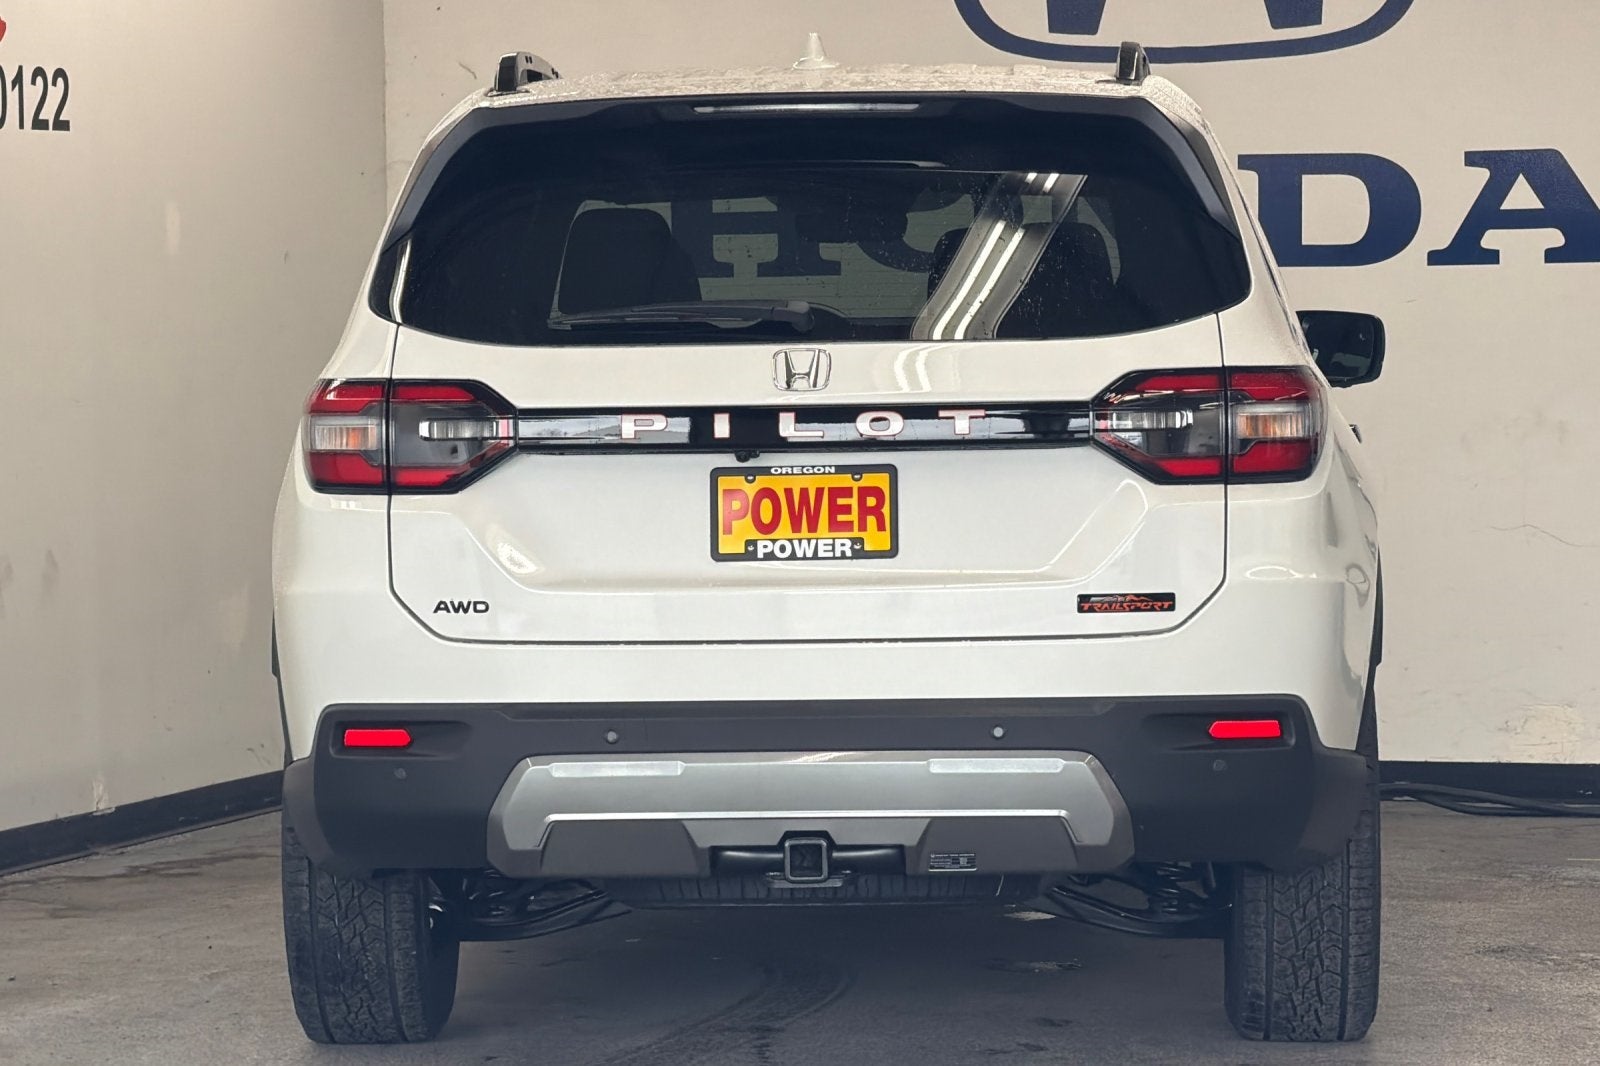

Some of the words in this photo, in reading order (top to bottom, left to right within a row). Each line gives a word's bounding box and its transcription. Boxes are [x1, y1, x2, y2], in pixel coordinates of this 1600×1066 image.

[621, 409, 986, 439] PILOT
[770, 466, 836, 475] OREGON
[722, 485, 887, 536] POWER
[756, 538, 853, 559] POWER
[432, 599, 490, 614] AWD
[1080, 601, 1173, 612] TRAILSPORT
